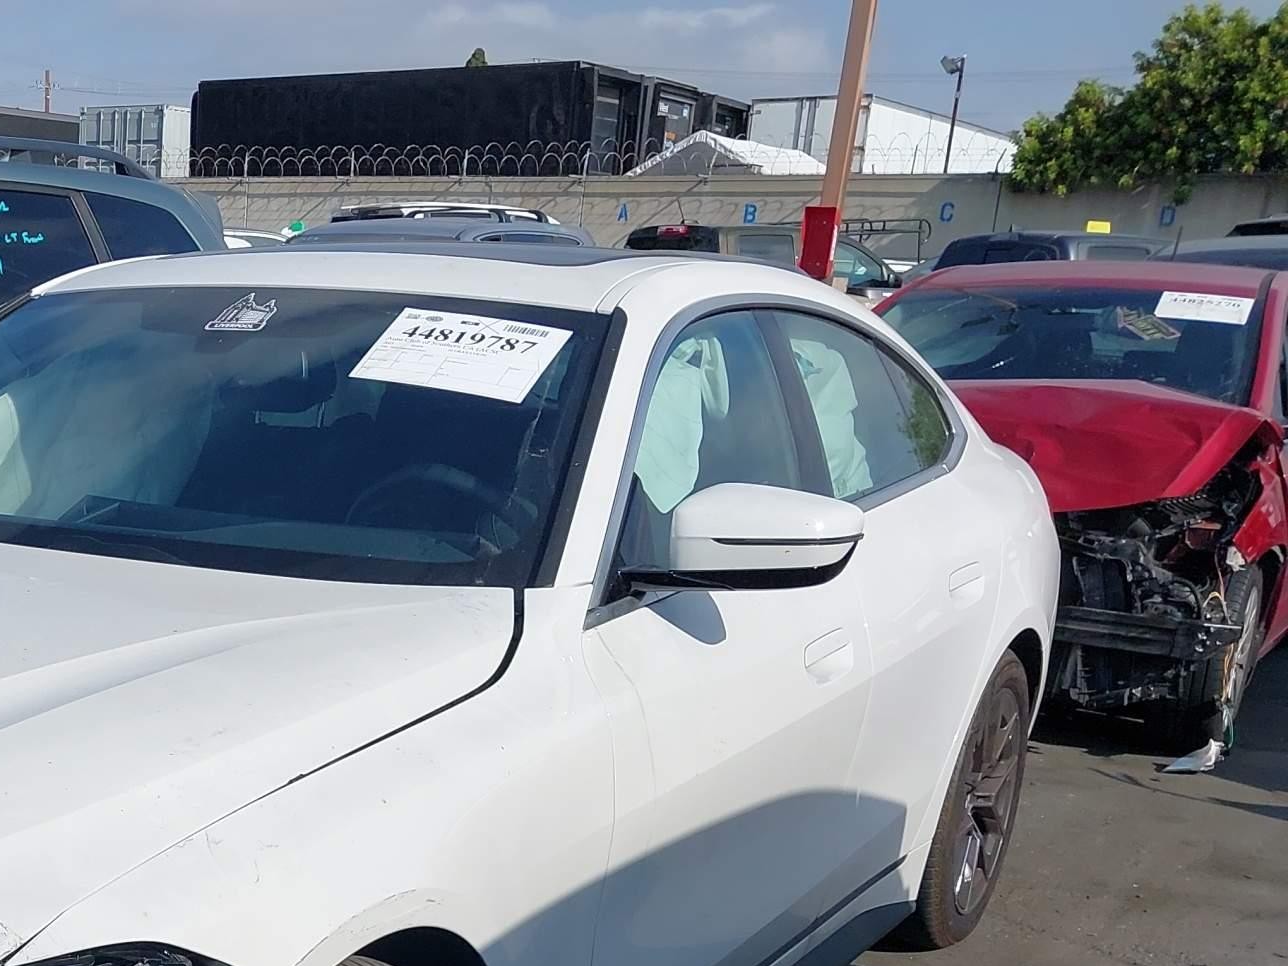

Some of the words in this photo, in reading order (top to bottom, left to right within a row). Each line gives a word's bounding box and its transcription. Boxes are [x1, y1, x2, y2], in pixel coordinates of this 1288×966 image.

[617, 203, 628, 221] A
[743, 203, 758, 224] B
[940, 202, 954, 222] C
[1160, 205, 1176, 225] D
[402, 325, 539, 354] 44819787
